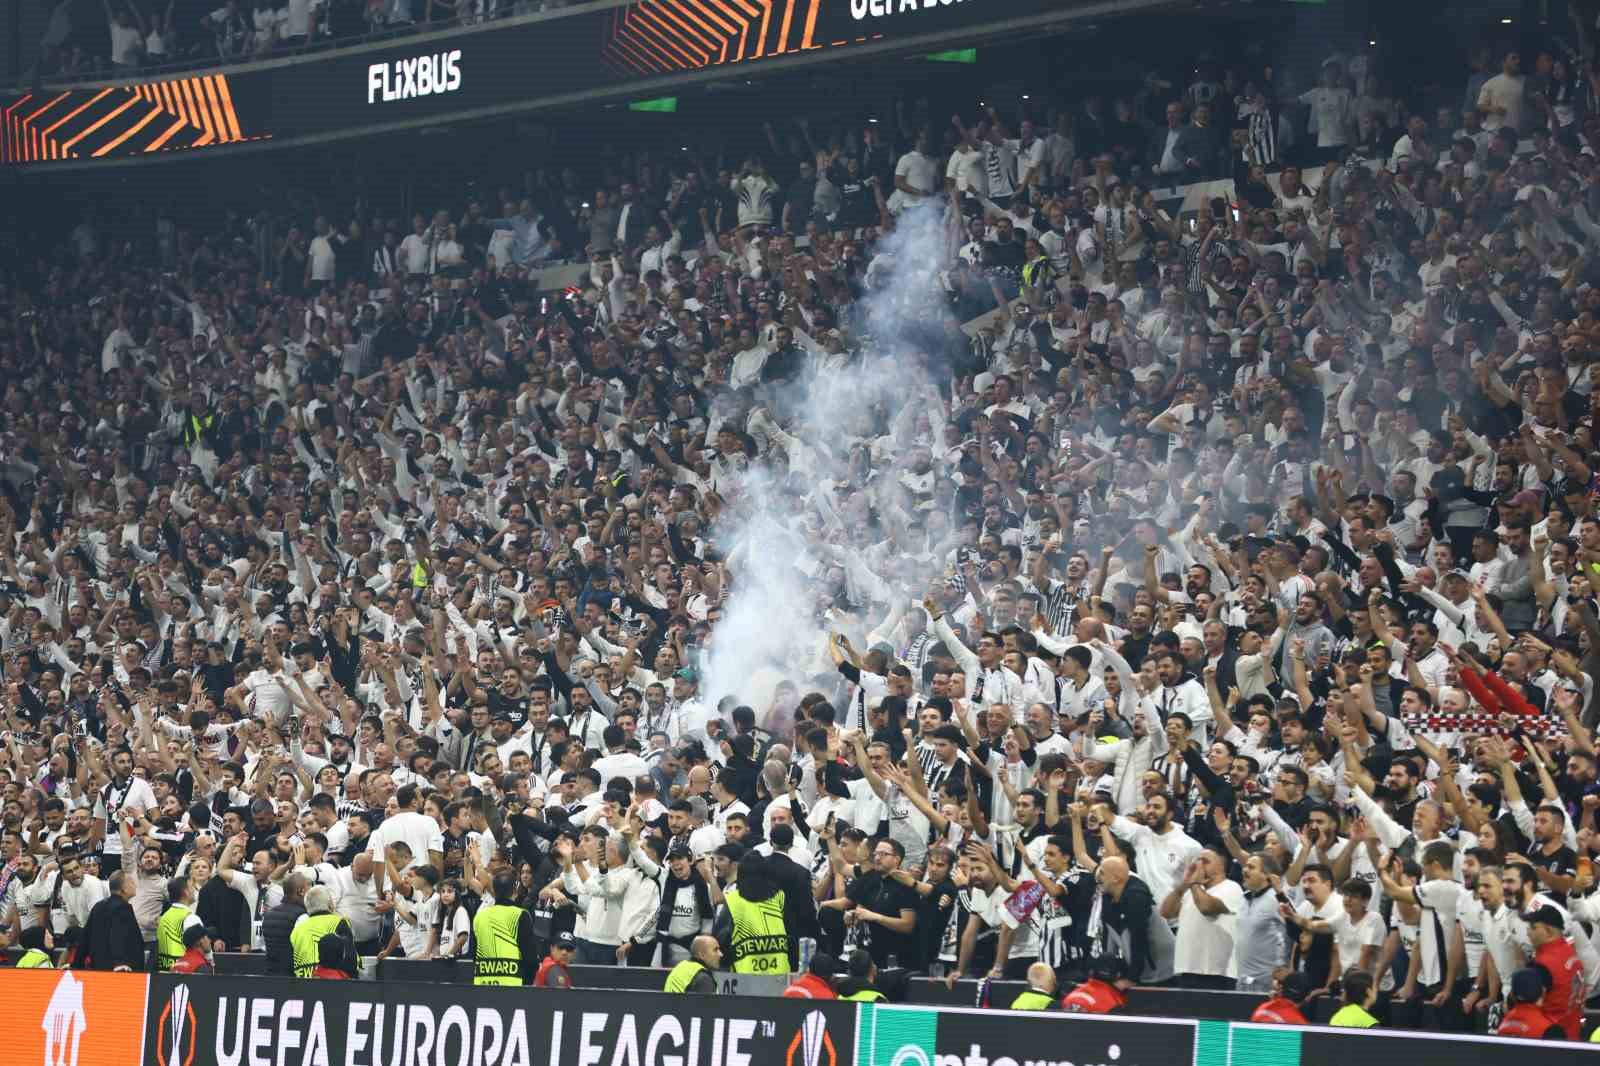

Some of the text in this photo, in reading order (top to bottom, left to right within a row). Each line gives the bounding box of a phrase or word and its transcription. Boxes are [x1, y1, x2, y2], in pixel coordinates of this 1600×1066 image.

[673, 905, 693, 915] eko
[476, 960, 519, 975] EWARD
[751, 958, 778, 971] 204
[215, 997, 329, 1066] UEFA
[345, 1002, 531, 1066] EUROPA
[550, 1011, 757, 1066] LEAGUE
